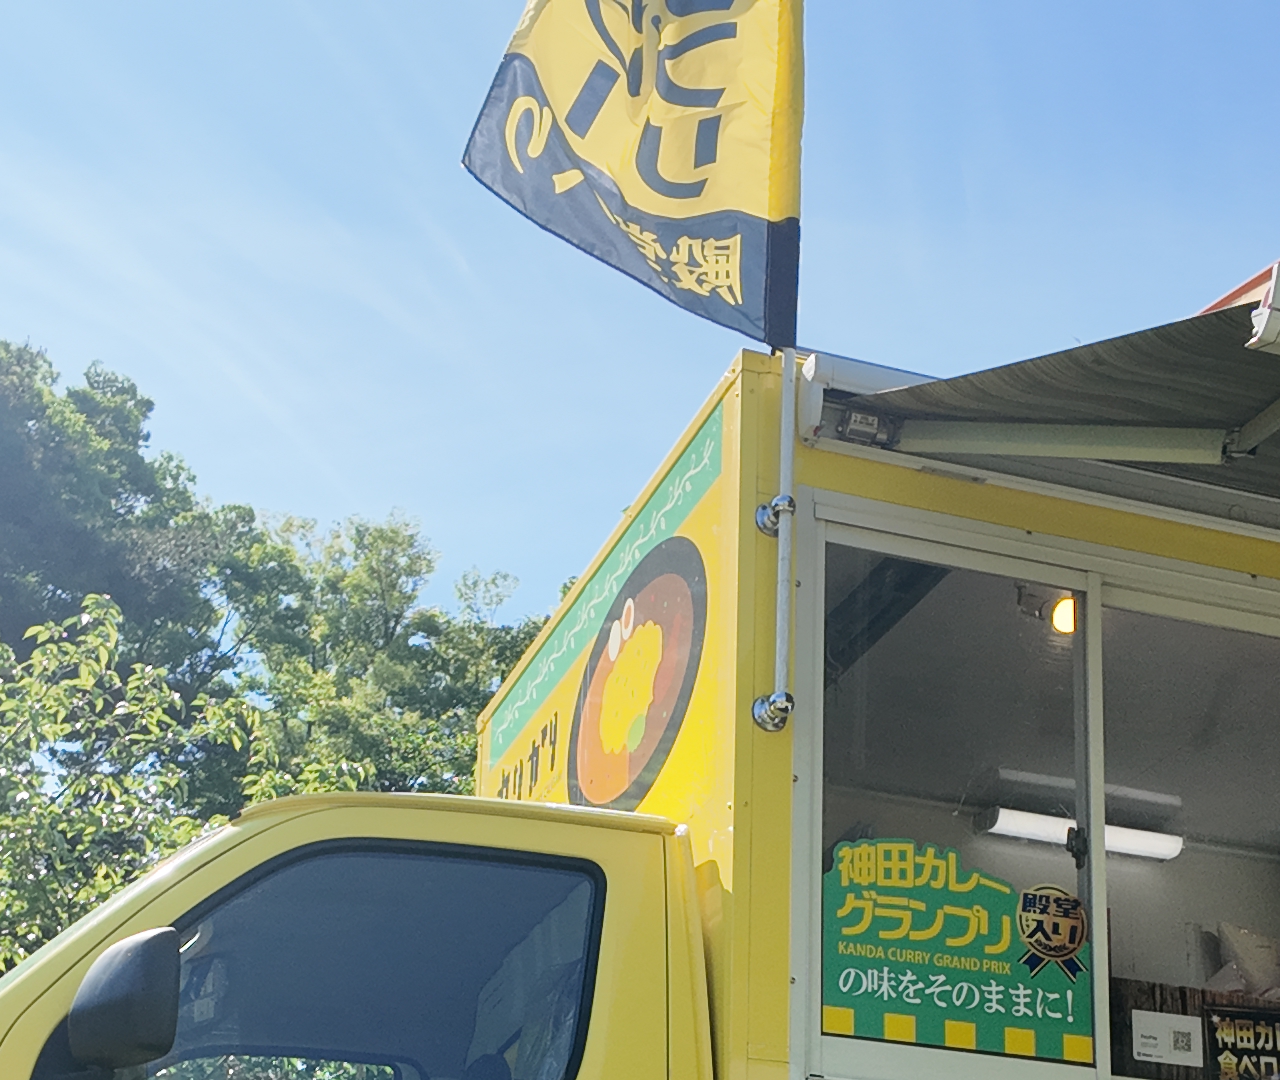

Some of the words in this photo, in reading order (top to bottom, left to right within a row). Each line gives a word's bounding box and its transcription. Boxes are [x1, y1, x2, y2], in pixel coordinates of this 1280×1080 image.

[837, 842, 1011, 895] 神田カレー
[836, 890, 1011, 955] グランプリ
[1022, 892, 1081, 920] 殿堂
[1026, 918, 1078, 945] 入り
[837, 940, 886, 960] KANDA
[887, 946, 931, 965] CURRY
[933, 953, 981, 972] GRAND
[982, 959, 1012, 975] PRIX
